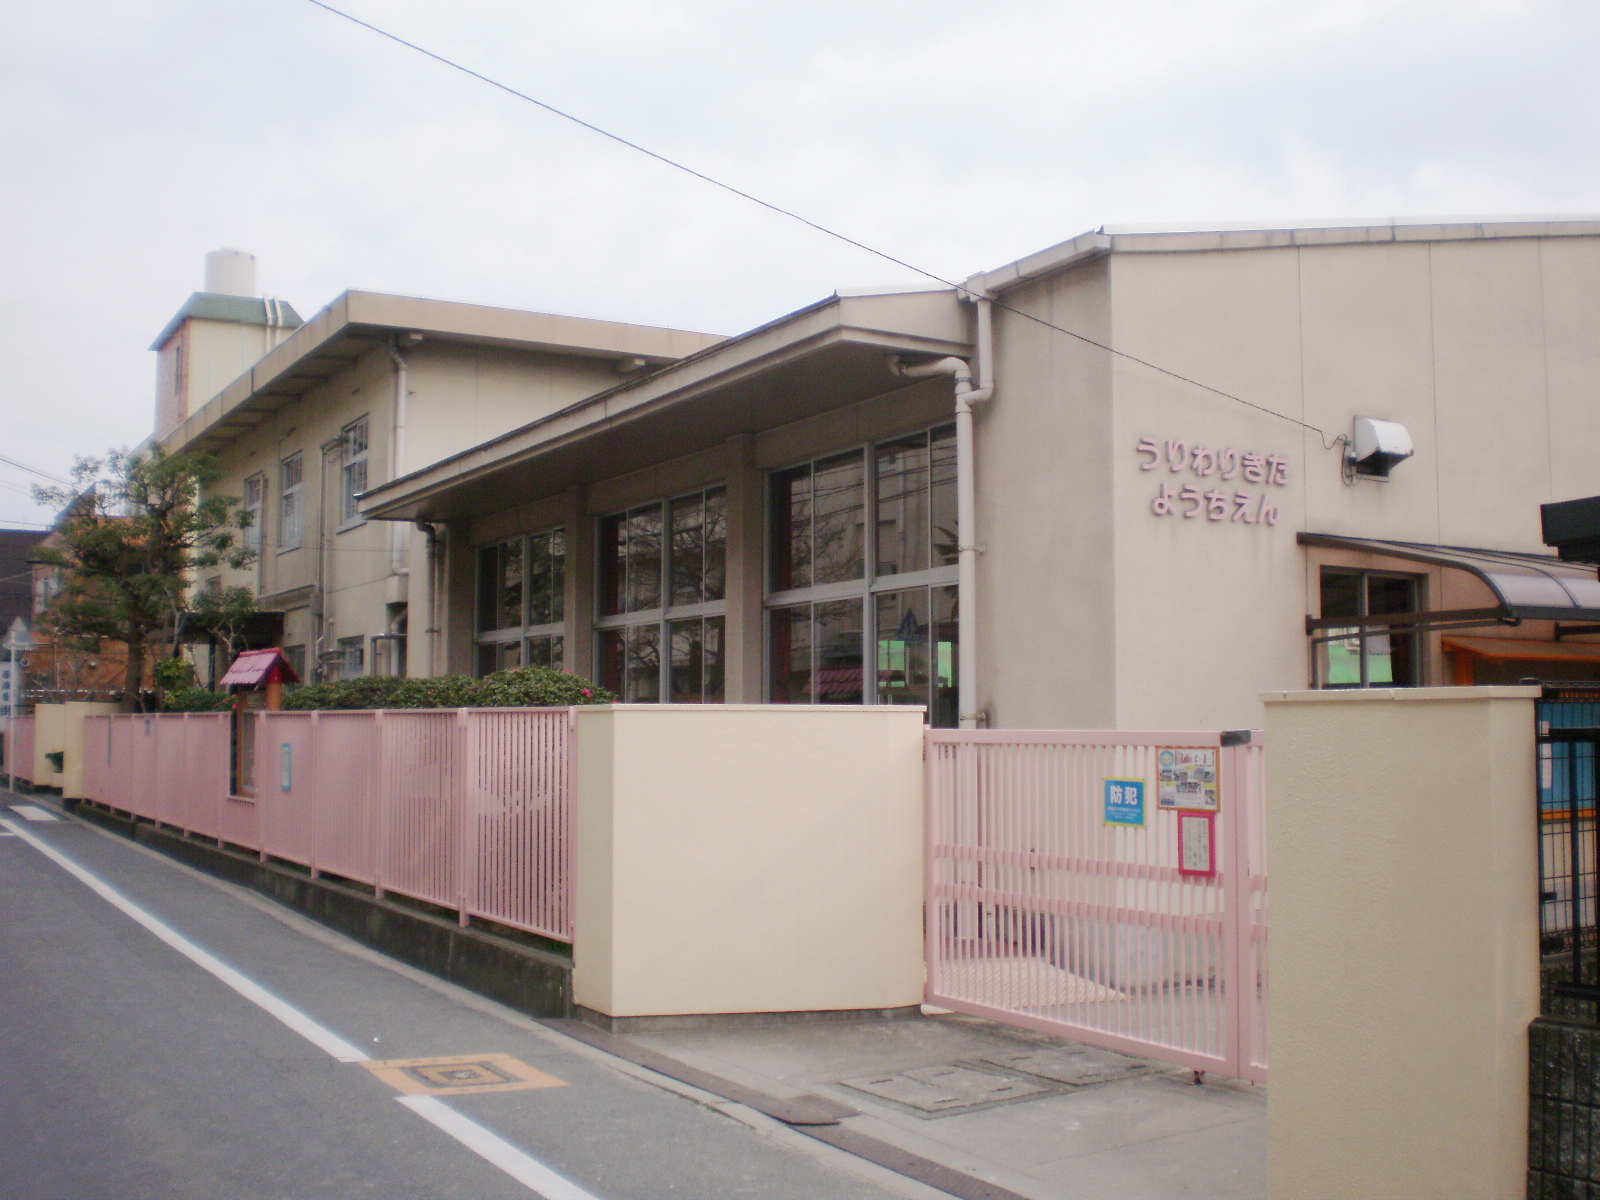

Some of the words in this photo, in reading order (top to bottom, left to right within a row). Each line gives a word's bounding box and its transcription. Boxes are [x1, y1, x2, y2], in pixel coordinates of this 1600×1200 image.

[1136, 435, 1290, 486] うりわりきた
[1152, 482, 1279, 526] ようちえん
[1110, 785, 1138, 805] 防犯
